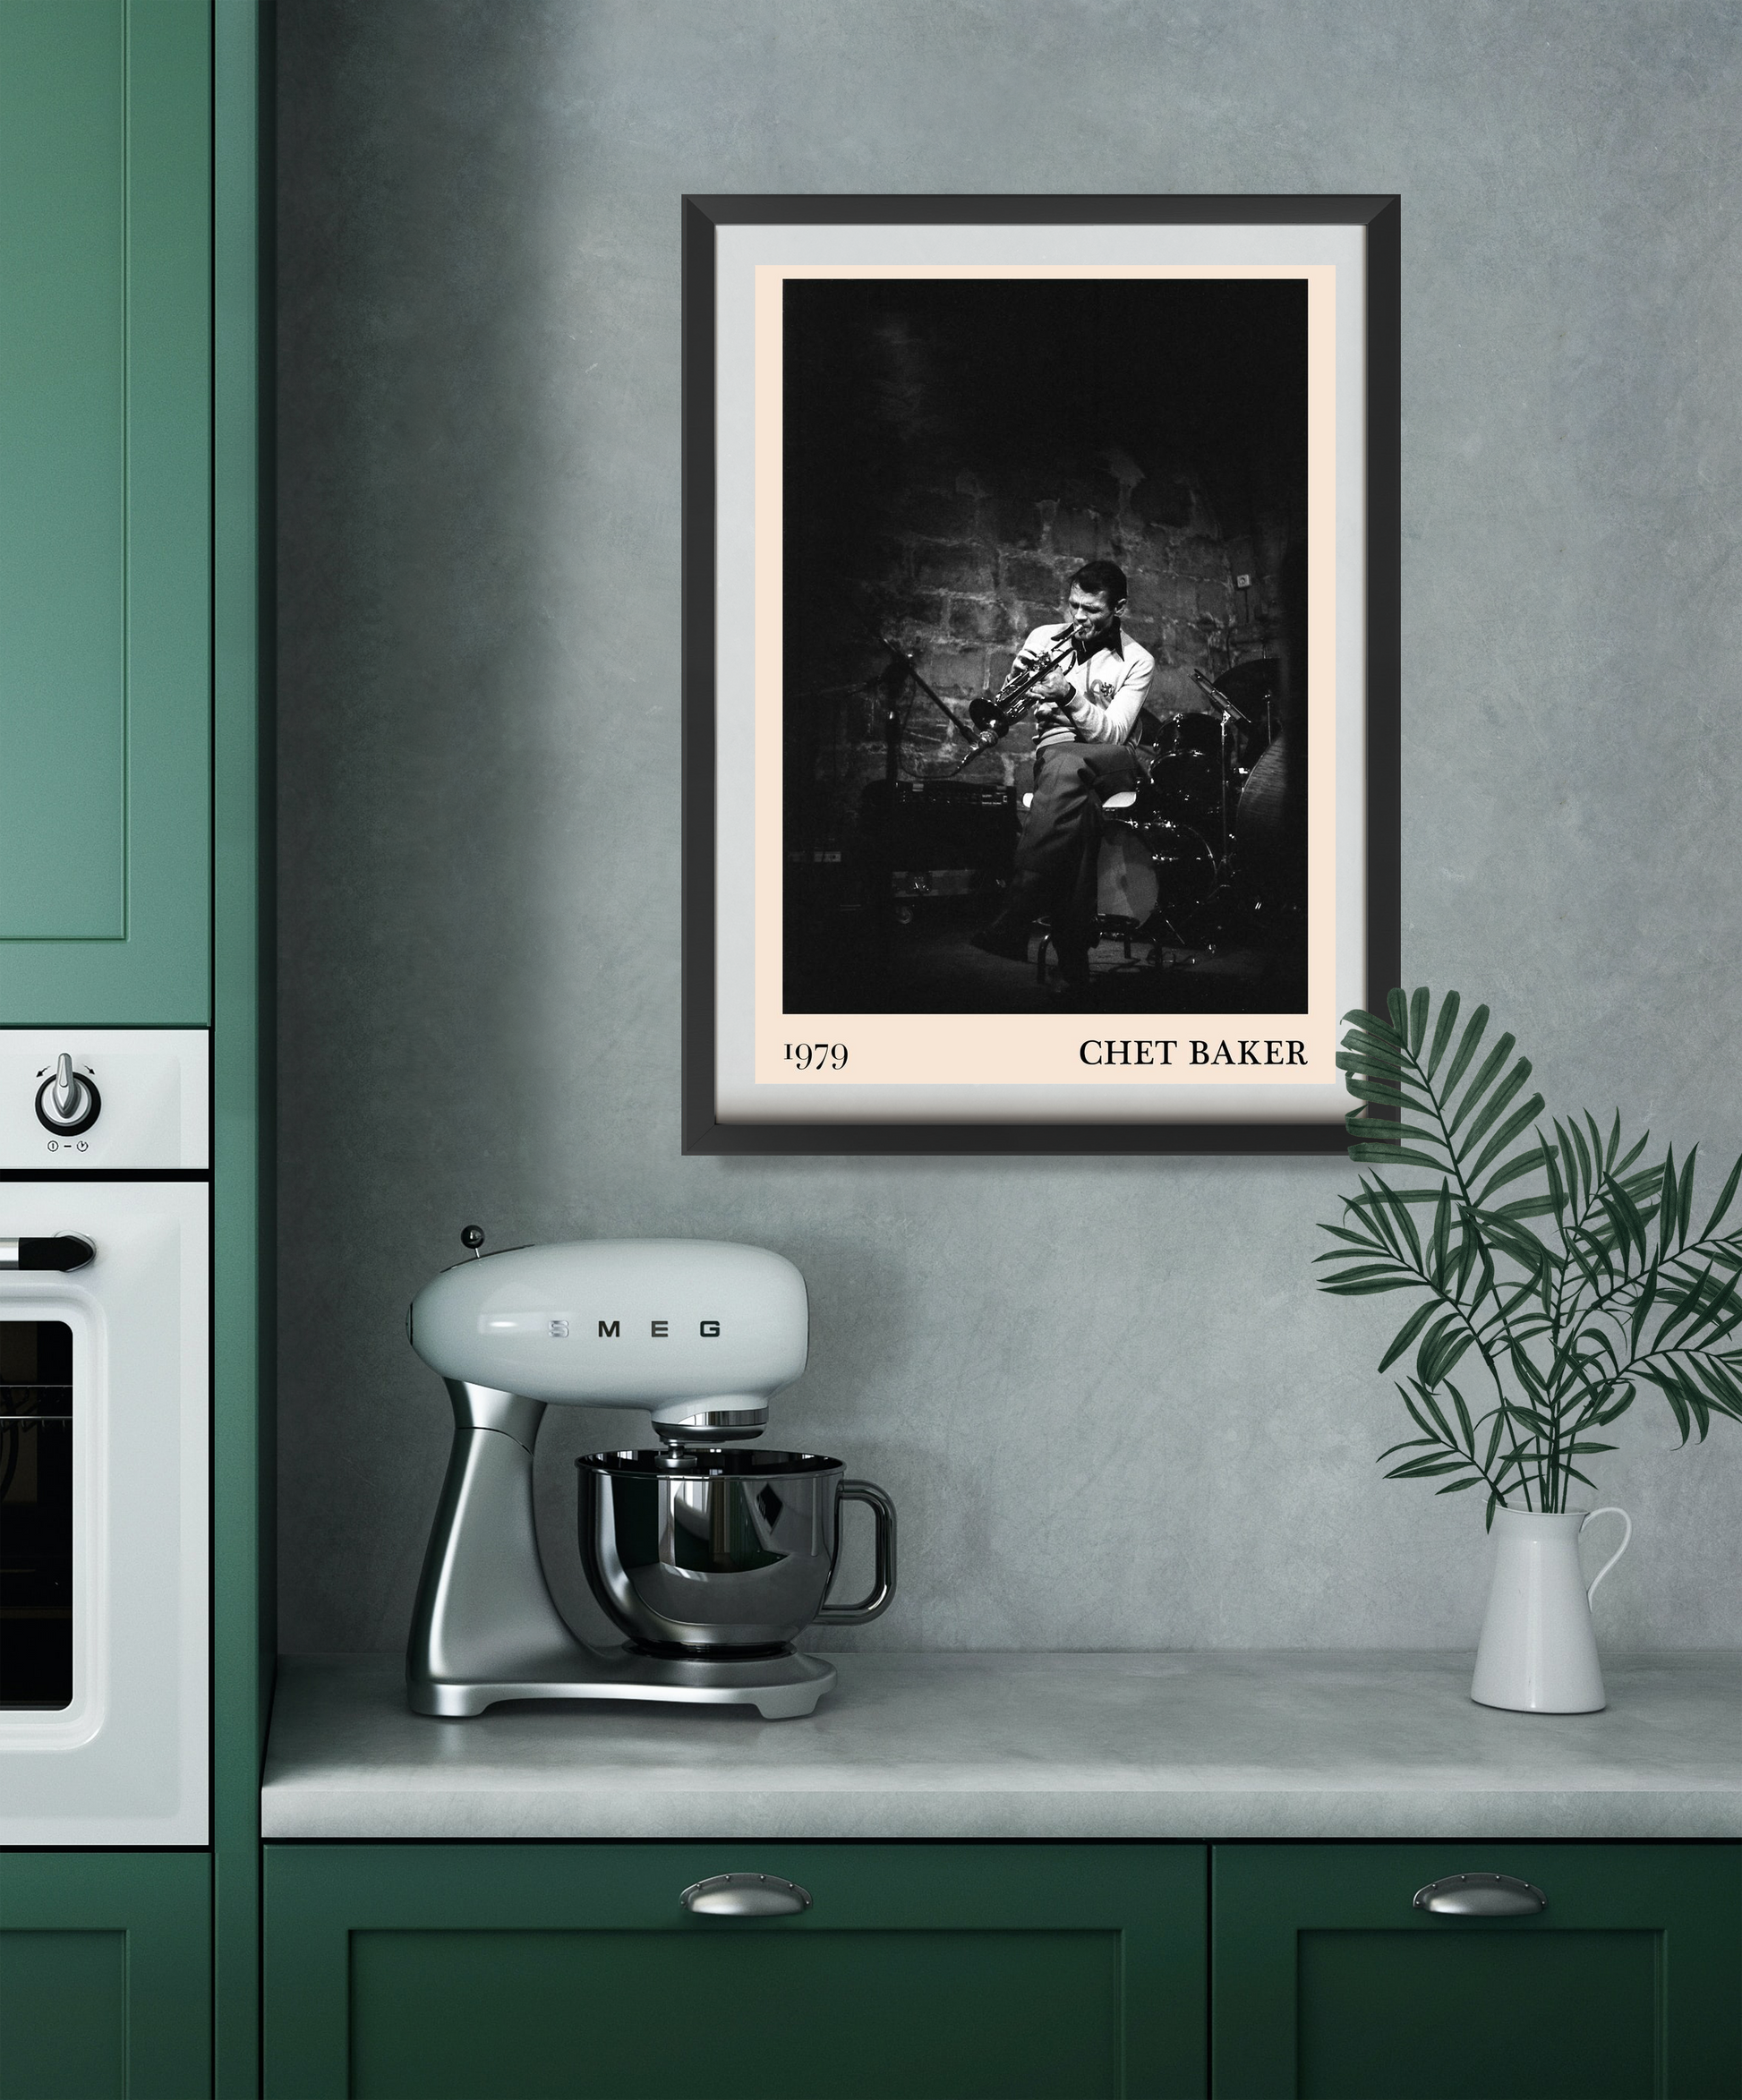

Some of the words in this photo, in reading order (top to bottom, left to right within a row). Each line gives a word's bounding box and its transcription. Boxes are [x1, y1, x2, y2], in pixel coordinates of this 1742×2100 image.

[783, 1043, 849, 1071] 1979
[1079, 1039, 1178, 1065] CHET
[1188, 1039, 1309, 1066] BAKER
[548, 1320, 721, 1338] SMEG
